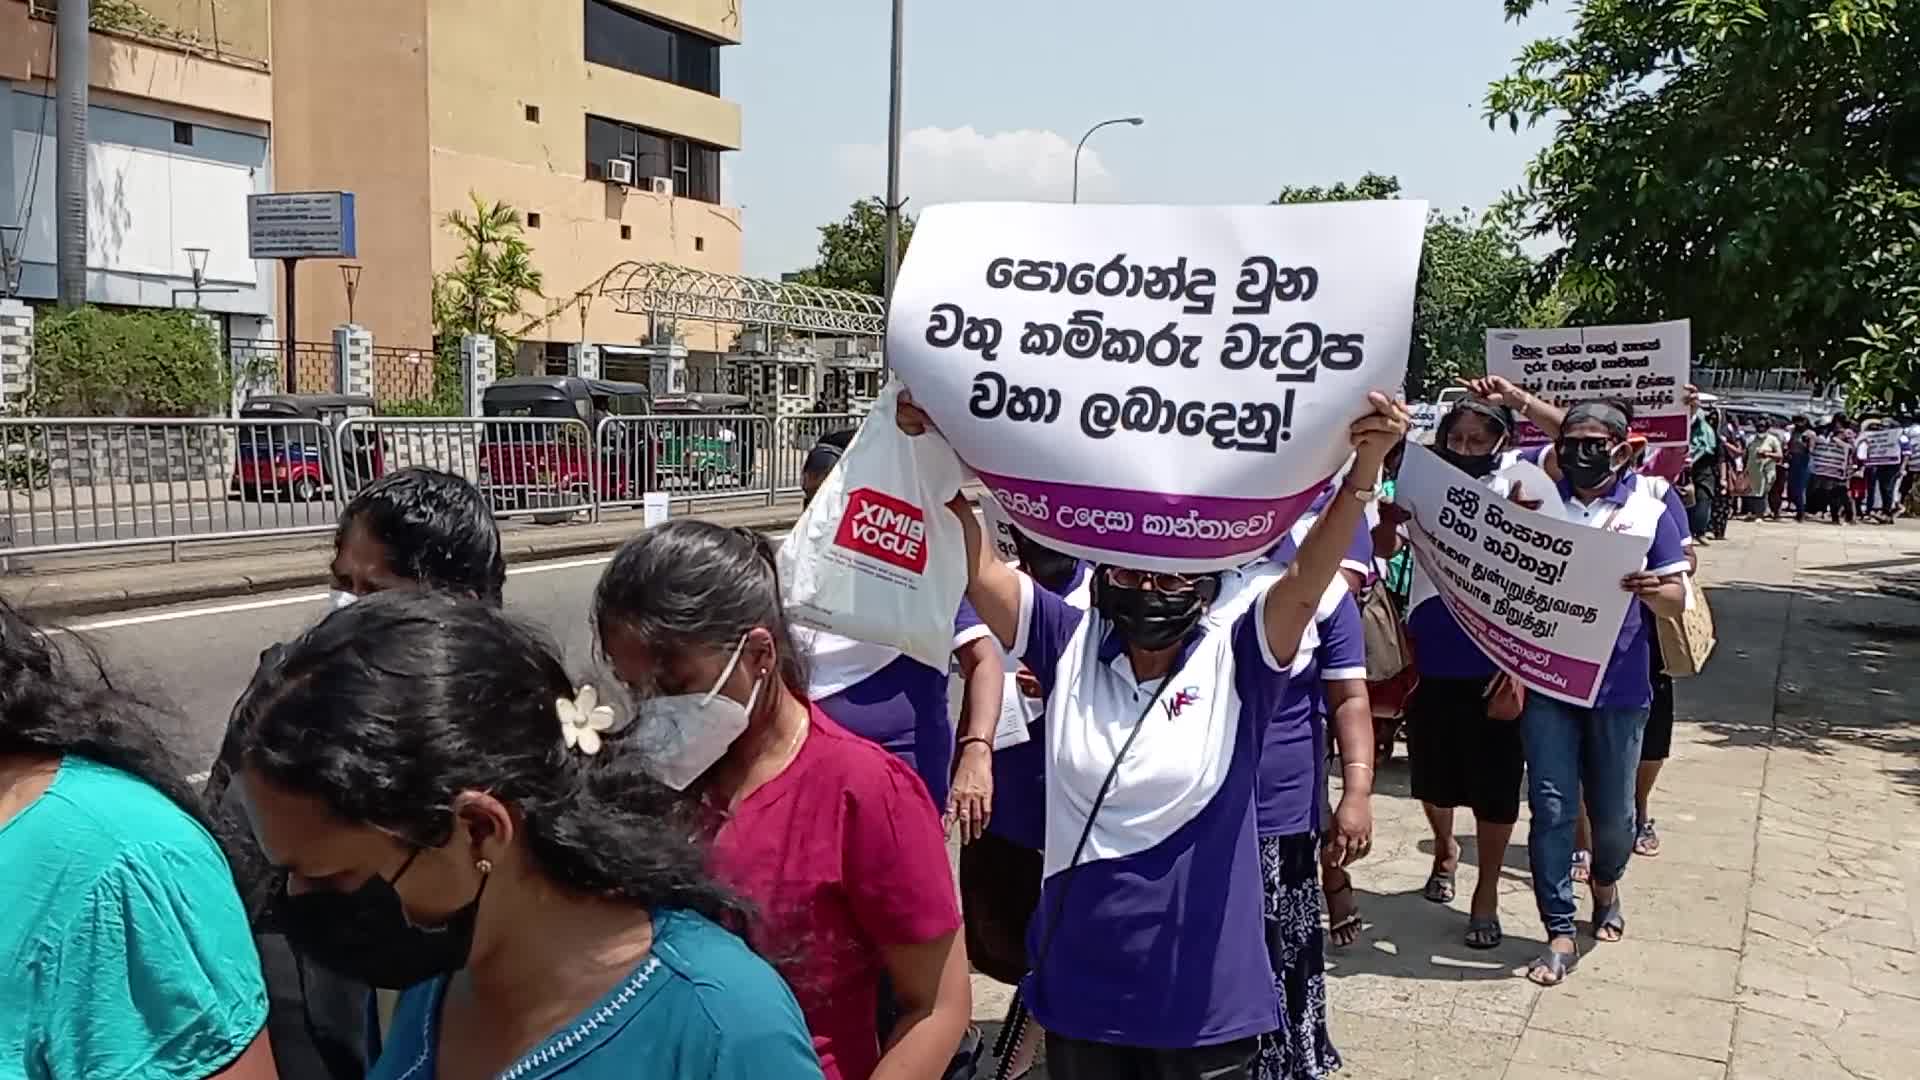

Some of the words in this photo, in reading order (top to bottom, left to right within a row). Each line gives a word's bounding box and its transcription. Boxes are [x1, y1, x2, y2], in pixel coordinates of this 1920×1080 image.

[986, 254, 1216, 315] පොරොන්දු
[1232, 256, 1319, 315] වුන
[925, 304, 1002, 361] වතු
[1020, 309, 1202, 368] කම්කරු
[1220, 322, 1364, 382] වැටුප
[968, 372, 1061, 423] වහා
[1080, 387, 1296, 454] ලබාදෙනු!
[851, 519, 921, 560] VOGUE
[1438, 506, 1478, 542] වහා
